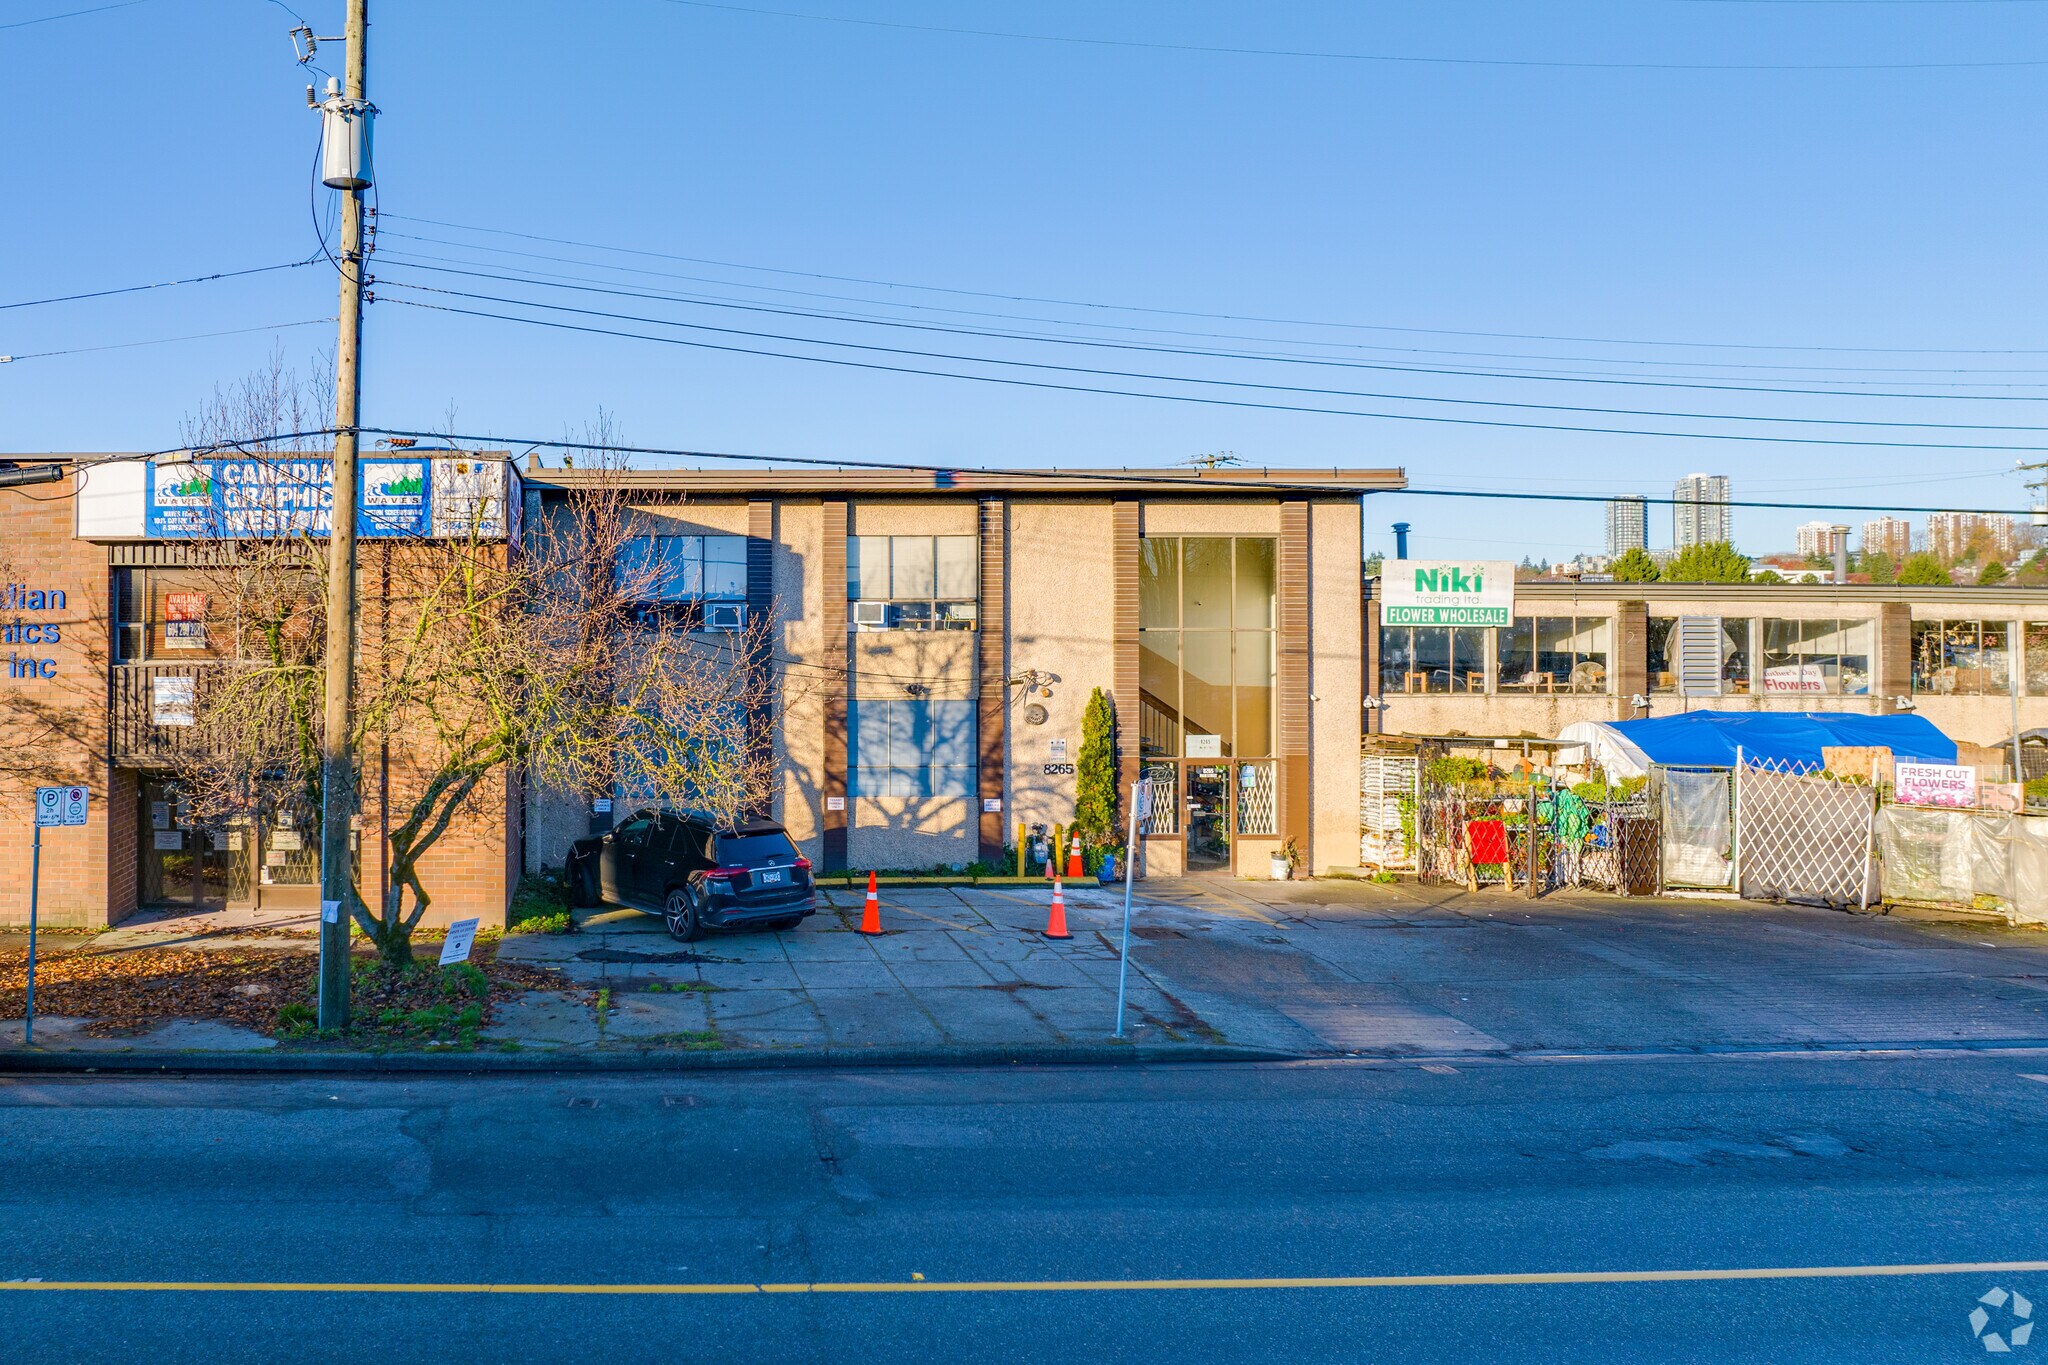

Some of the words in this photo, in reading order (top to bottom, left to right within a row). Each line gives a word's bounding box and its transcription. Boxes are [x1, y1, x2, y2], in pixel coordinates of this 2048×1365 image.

[223, 464, 333, 484] CANADIA
[223, 486, 333, 507] GRAPHIC
[311, 511, 333, 530] IN
[1415, 564, 1484, 592] Niki
[169, 594, 203, 604] AVAILABLE
[1416, 595, 1460, 606] trading
[1464, 595, 1482, 604] ltd.
[1389, 608, 1435, 622] FLOWER
[1439, 608, 1506, 623] WHOLESALE
[1801, 669, 1817, 677] Day
[1764, 678, 1821, 690] Flowers
[1044, 764, 1074, 775] 8265
[1901, 767, 1941, 778] FRESH
[1946, 769, 1970, 779] CUT
[1904, 778, 1966, 790] FLOWERS
